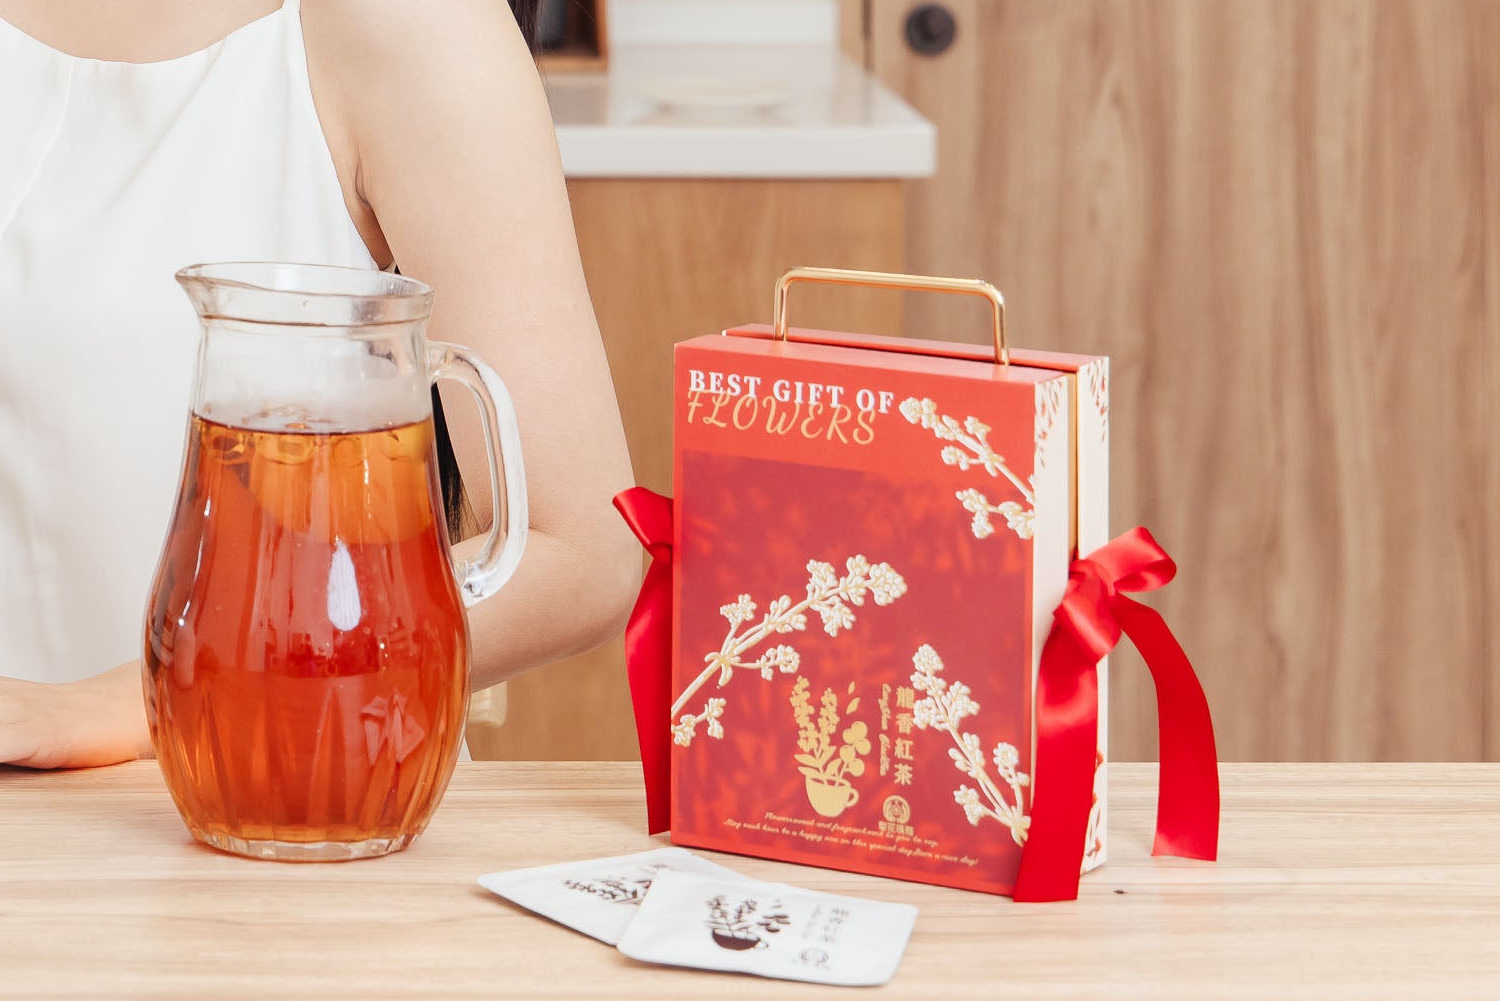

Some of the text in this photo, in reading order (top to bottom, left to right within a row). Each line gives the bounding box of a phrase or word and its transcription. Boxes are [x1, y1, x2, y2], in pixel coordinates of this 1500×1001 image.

[687, 388, 876, 445] FLOWERS
[688, 369, 895, 414] BEST GIFT OF
